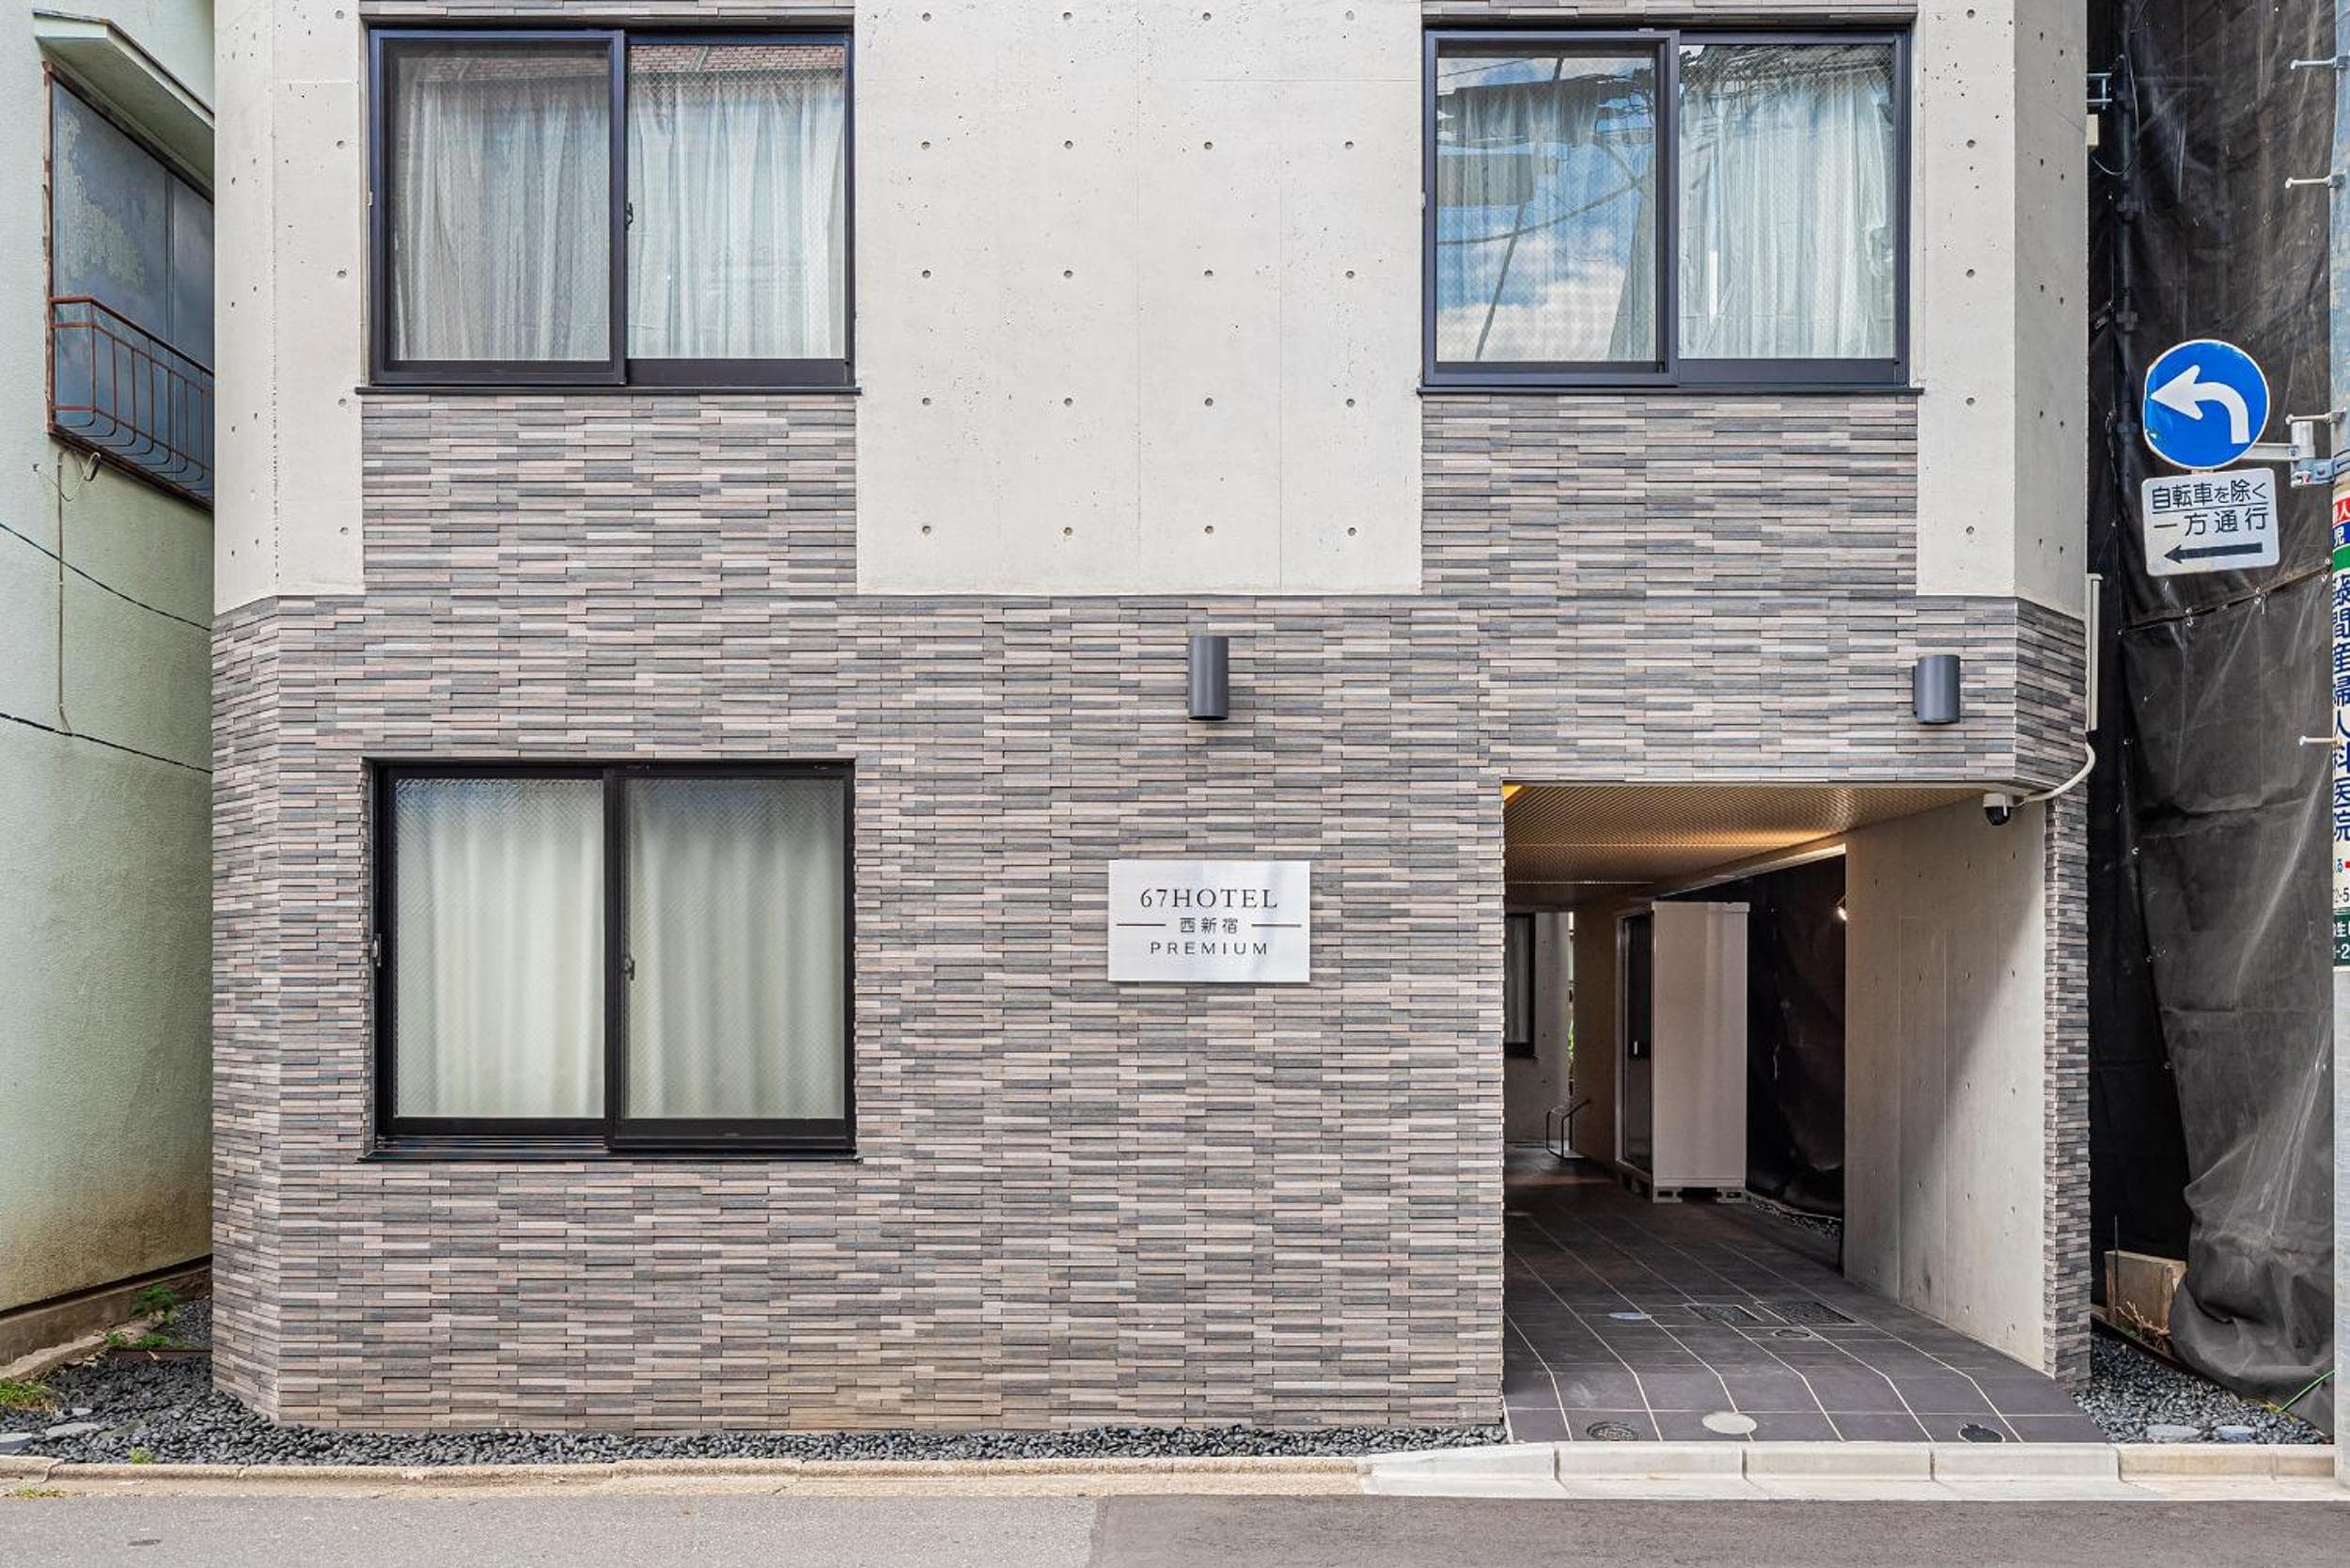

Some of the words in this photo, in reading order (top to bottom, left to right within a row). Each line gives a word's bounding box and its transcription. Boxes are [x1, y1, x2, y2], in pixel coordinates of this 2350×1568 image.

[2152, 478, 2267, 510] 自転車を除く
[2154, 507, 2268, 537] 一方通行
[1139, 887, 1278, 909] 67HOTEL
[1180, 917, 1239, 933] 西新宿
[1150, 941, 1268, 955] PREMIUM
